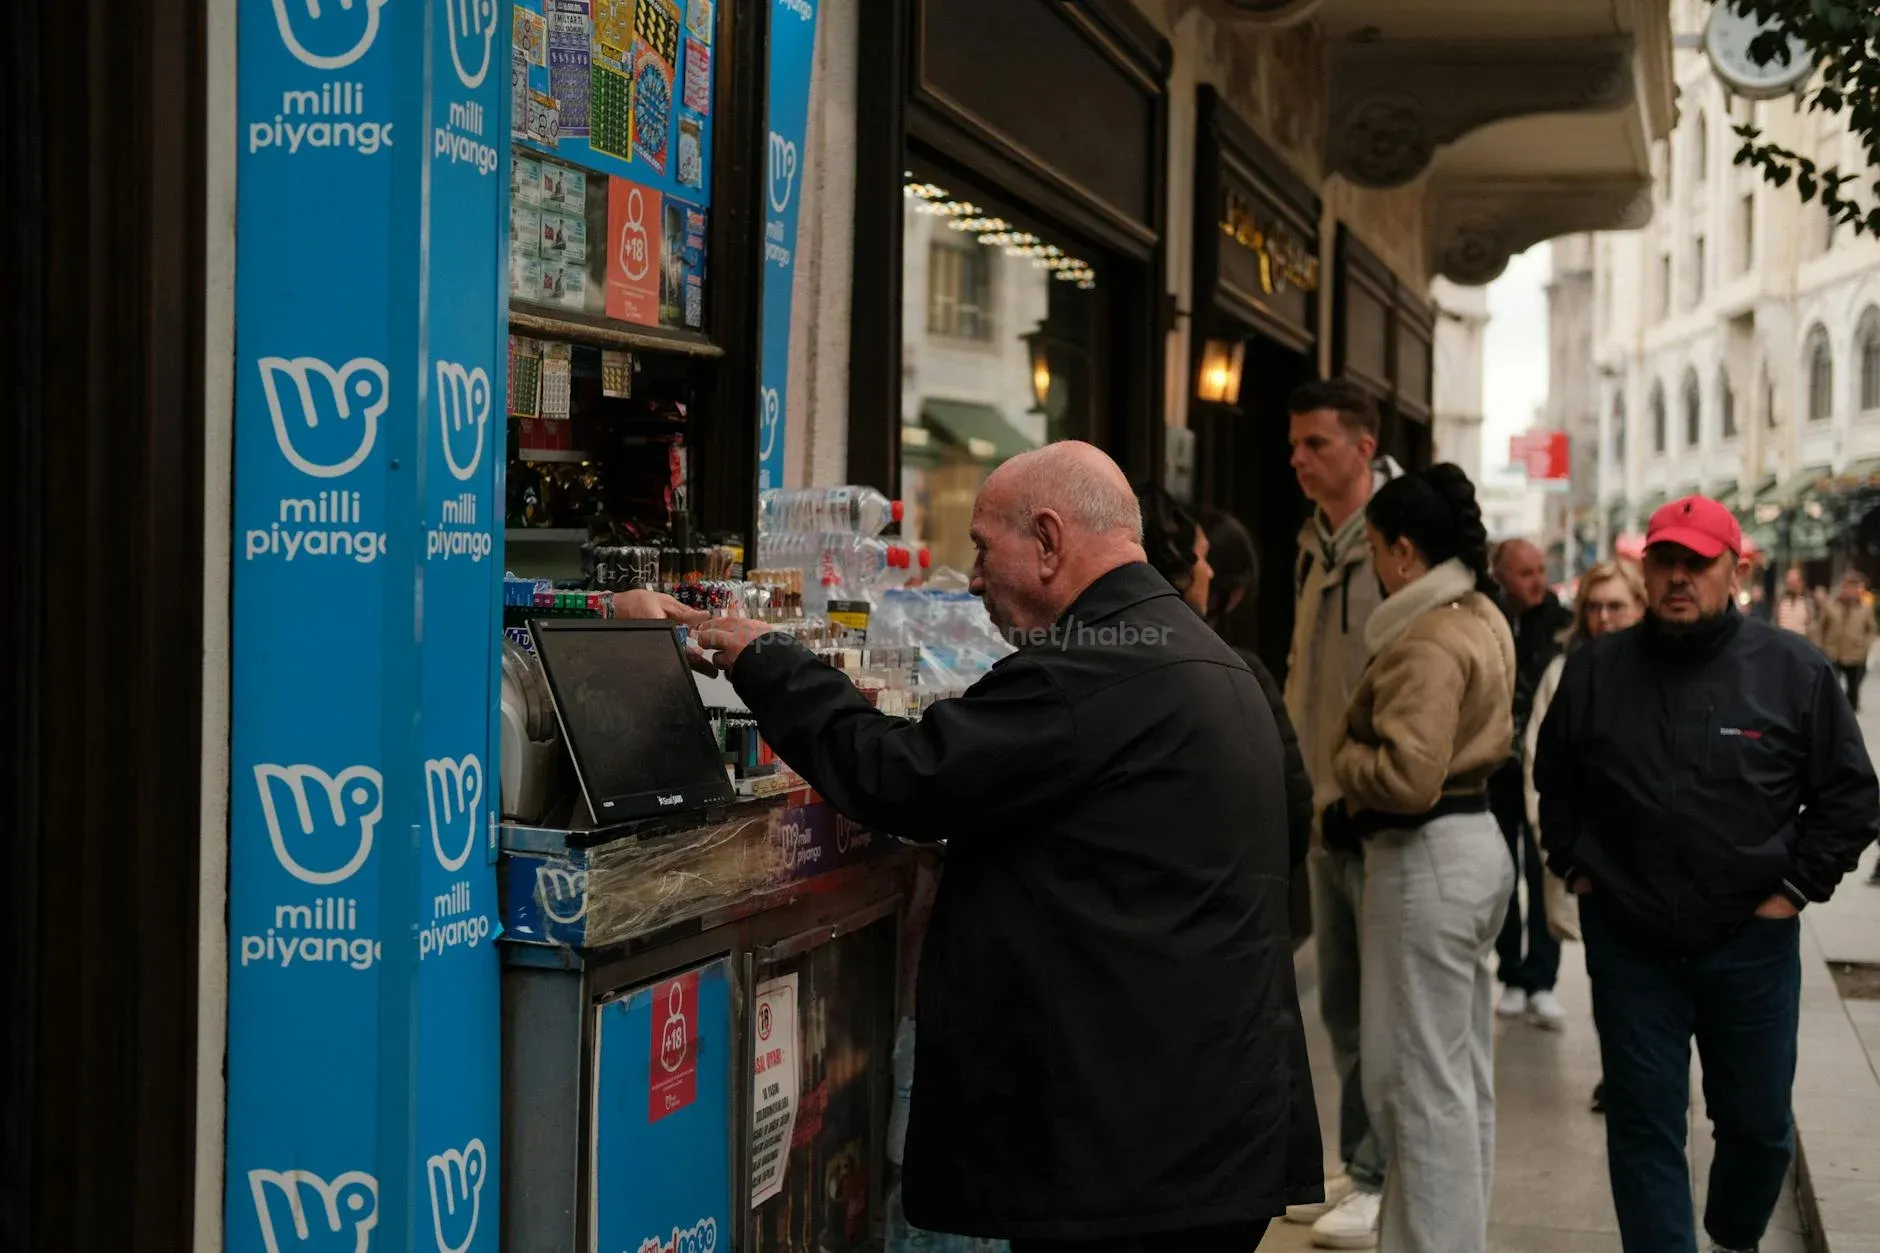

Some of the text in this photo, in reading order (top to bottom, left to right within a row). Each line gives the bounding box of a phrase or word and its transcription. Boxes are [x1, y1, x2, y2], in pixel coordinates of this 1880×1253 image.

[283, 82, 363, 115] milli
[450, 101, 483, 136] milli
[435, 124, 498, 176] piyango
[625, 238, 643, 261] +18
[280, 490, 360, 524] milli
[442, 493, 476, 524] milli
[427, 523, 492, 562] piyango
[275, 897, 356, 930] milli
[434, 881, 470, 919] milli
[241, 929, 382, 970] piyang
[419, 915, 489, 960] piyango
[666, 1026, 682, 1052] +18
